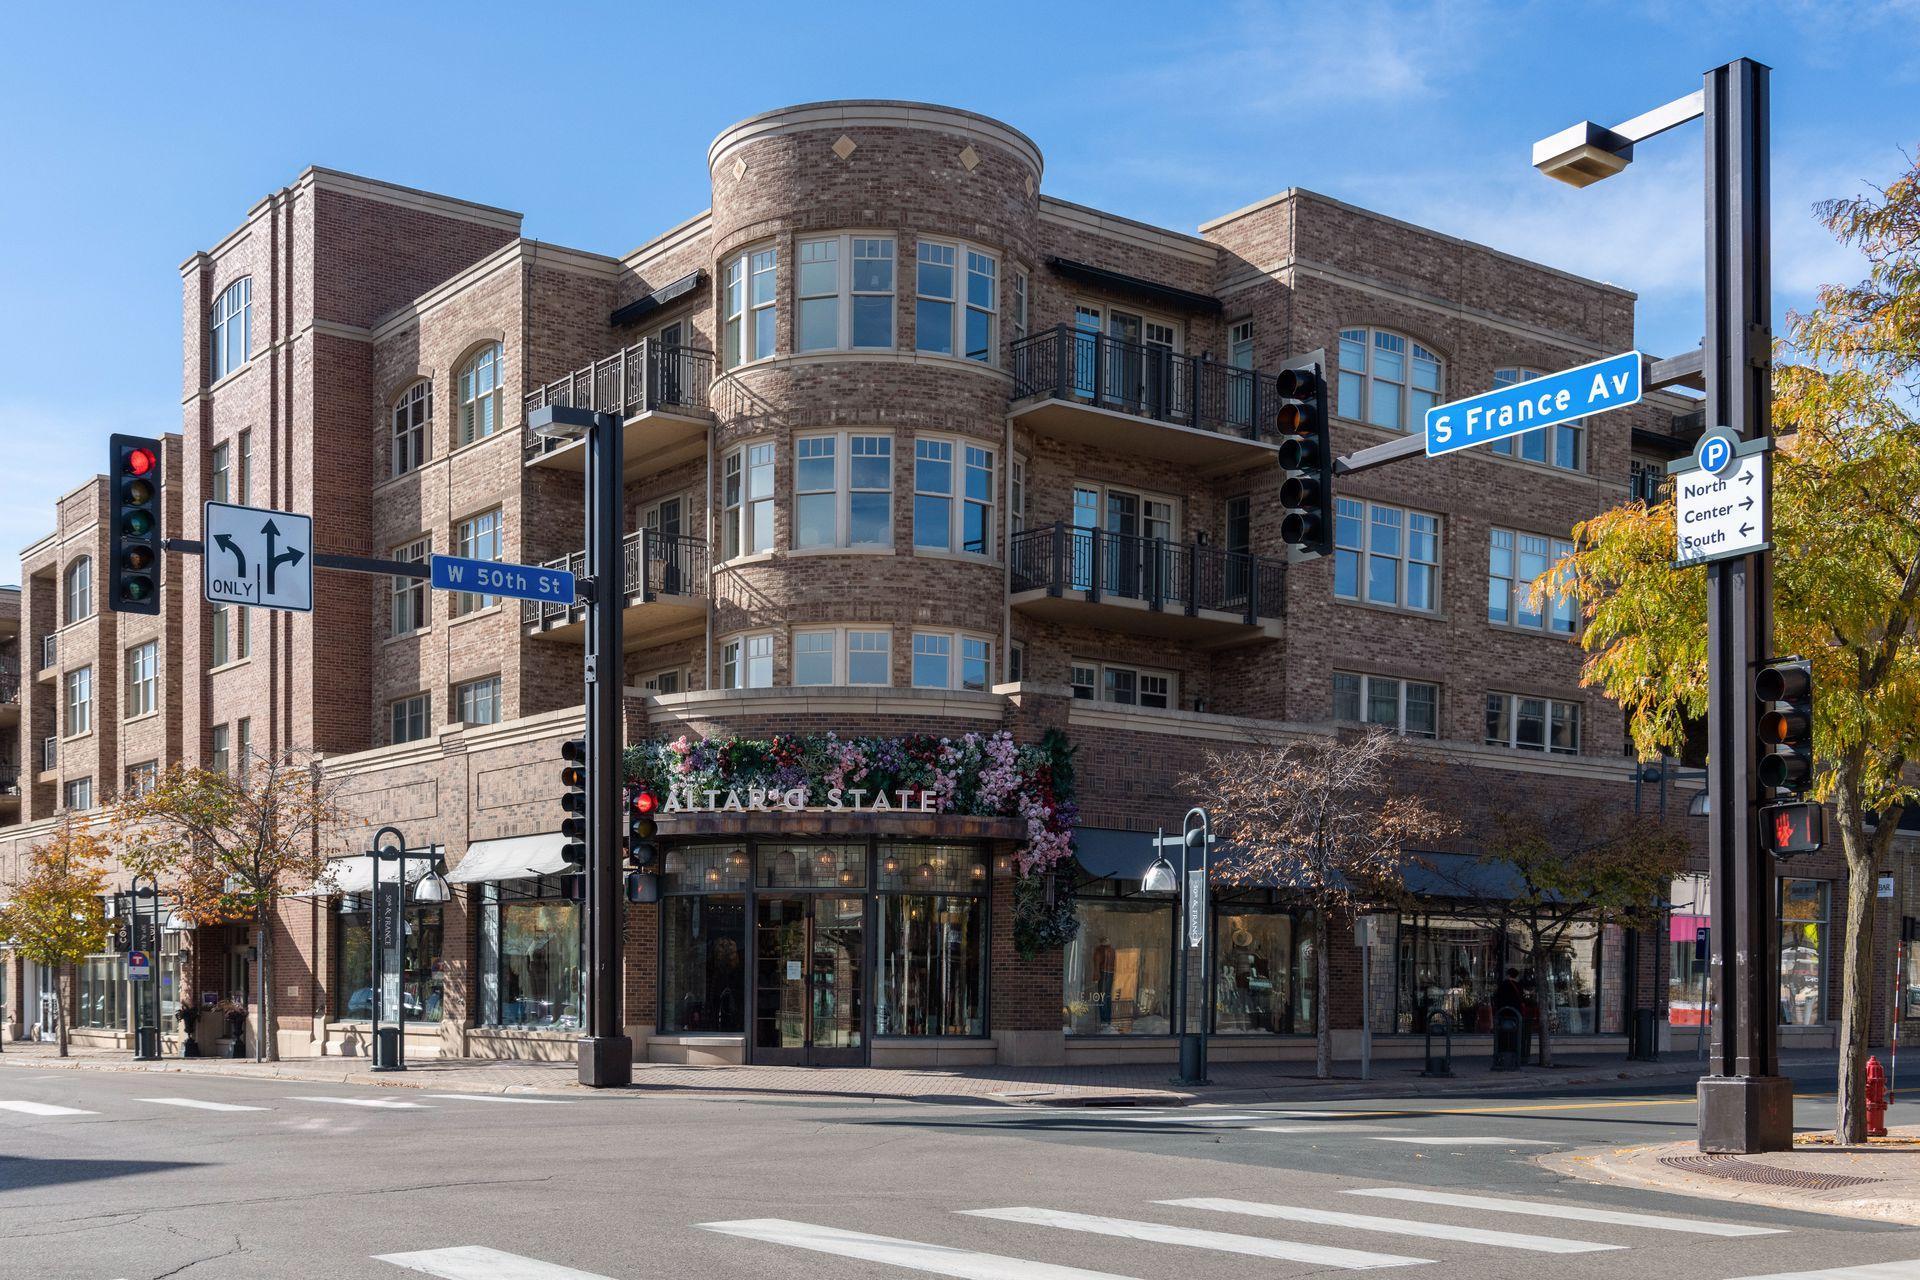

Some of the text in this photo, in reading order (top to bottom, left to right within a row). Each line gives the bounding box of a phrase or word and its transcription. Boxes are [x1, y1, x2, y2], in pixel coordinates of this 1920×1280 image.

[1435, 371, 1630, 443] S France Av
[1708, 444, 1724, 468] P
[1684, 478, 1727, 499] North
[1684, 504, 1734, 524] Center
[1684, 530, 1726, 549] South
[212, 579, 253, 597] ONLY
[447, 564, 560, 595] W 50th St
[826, 789, 938, 813] STATE
